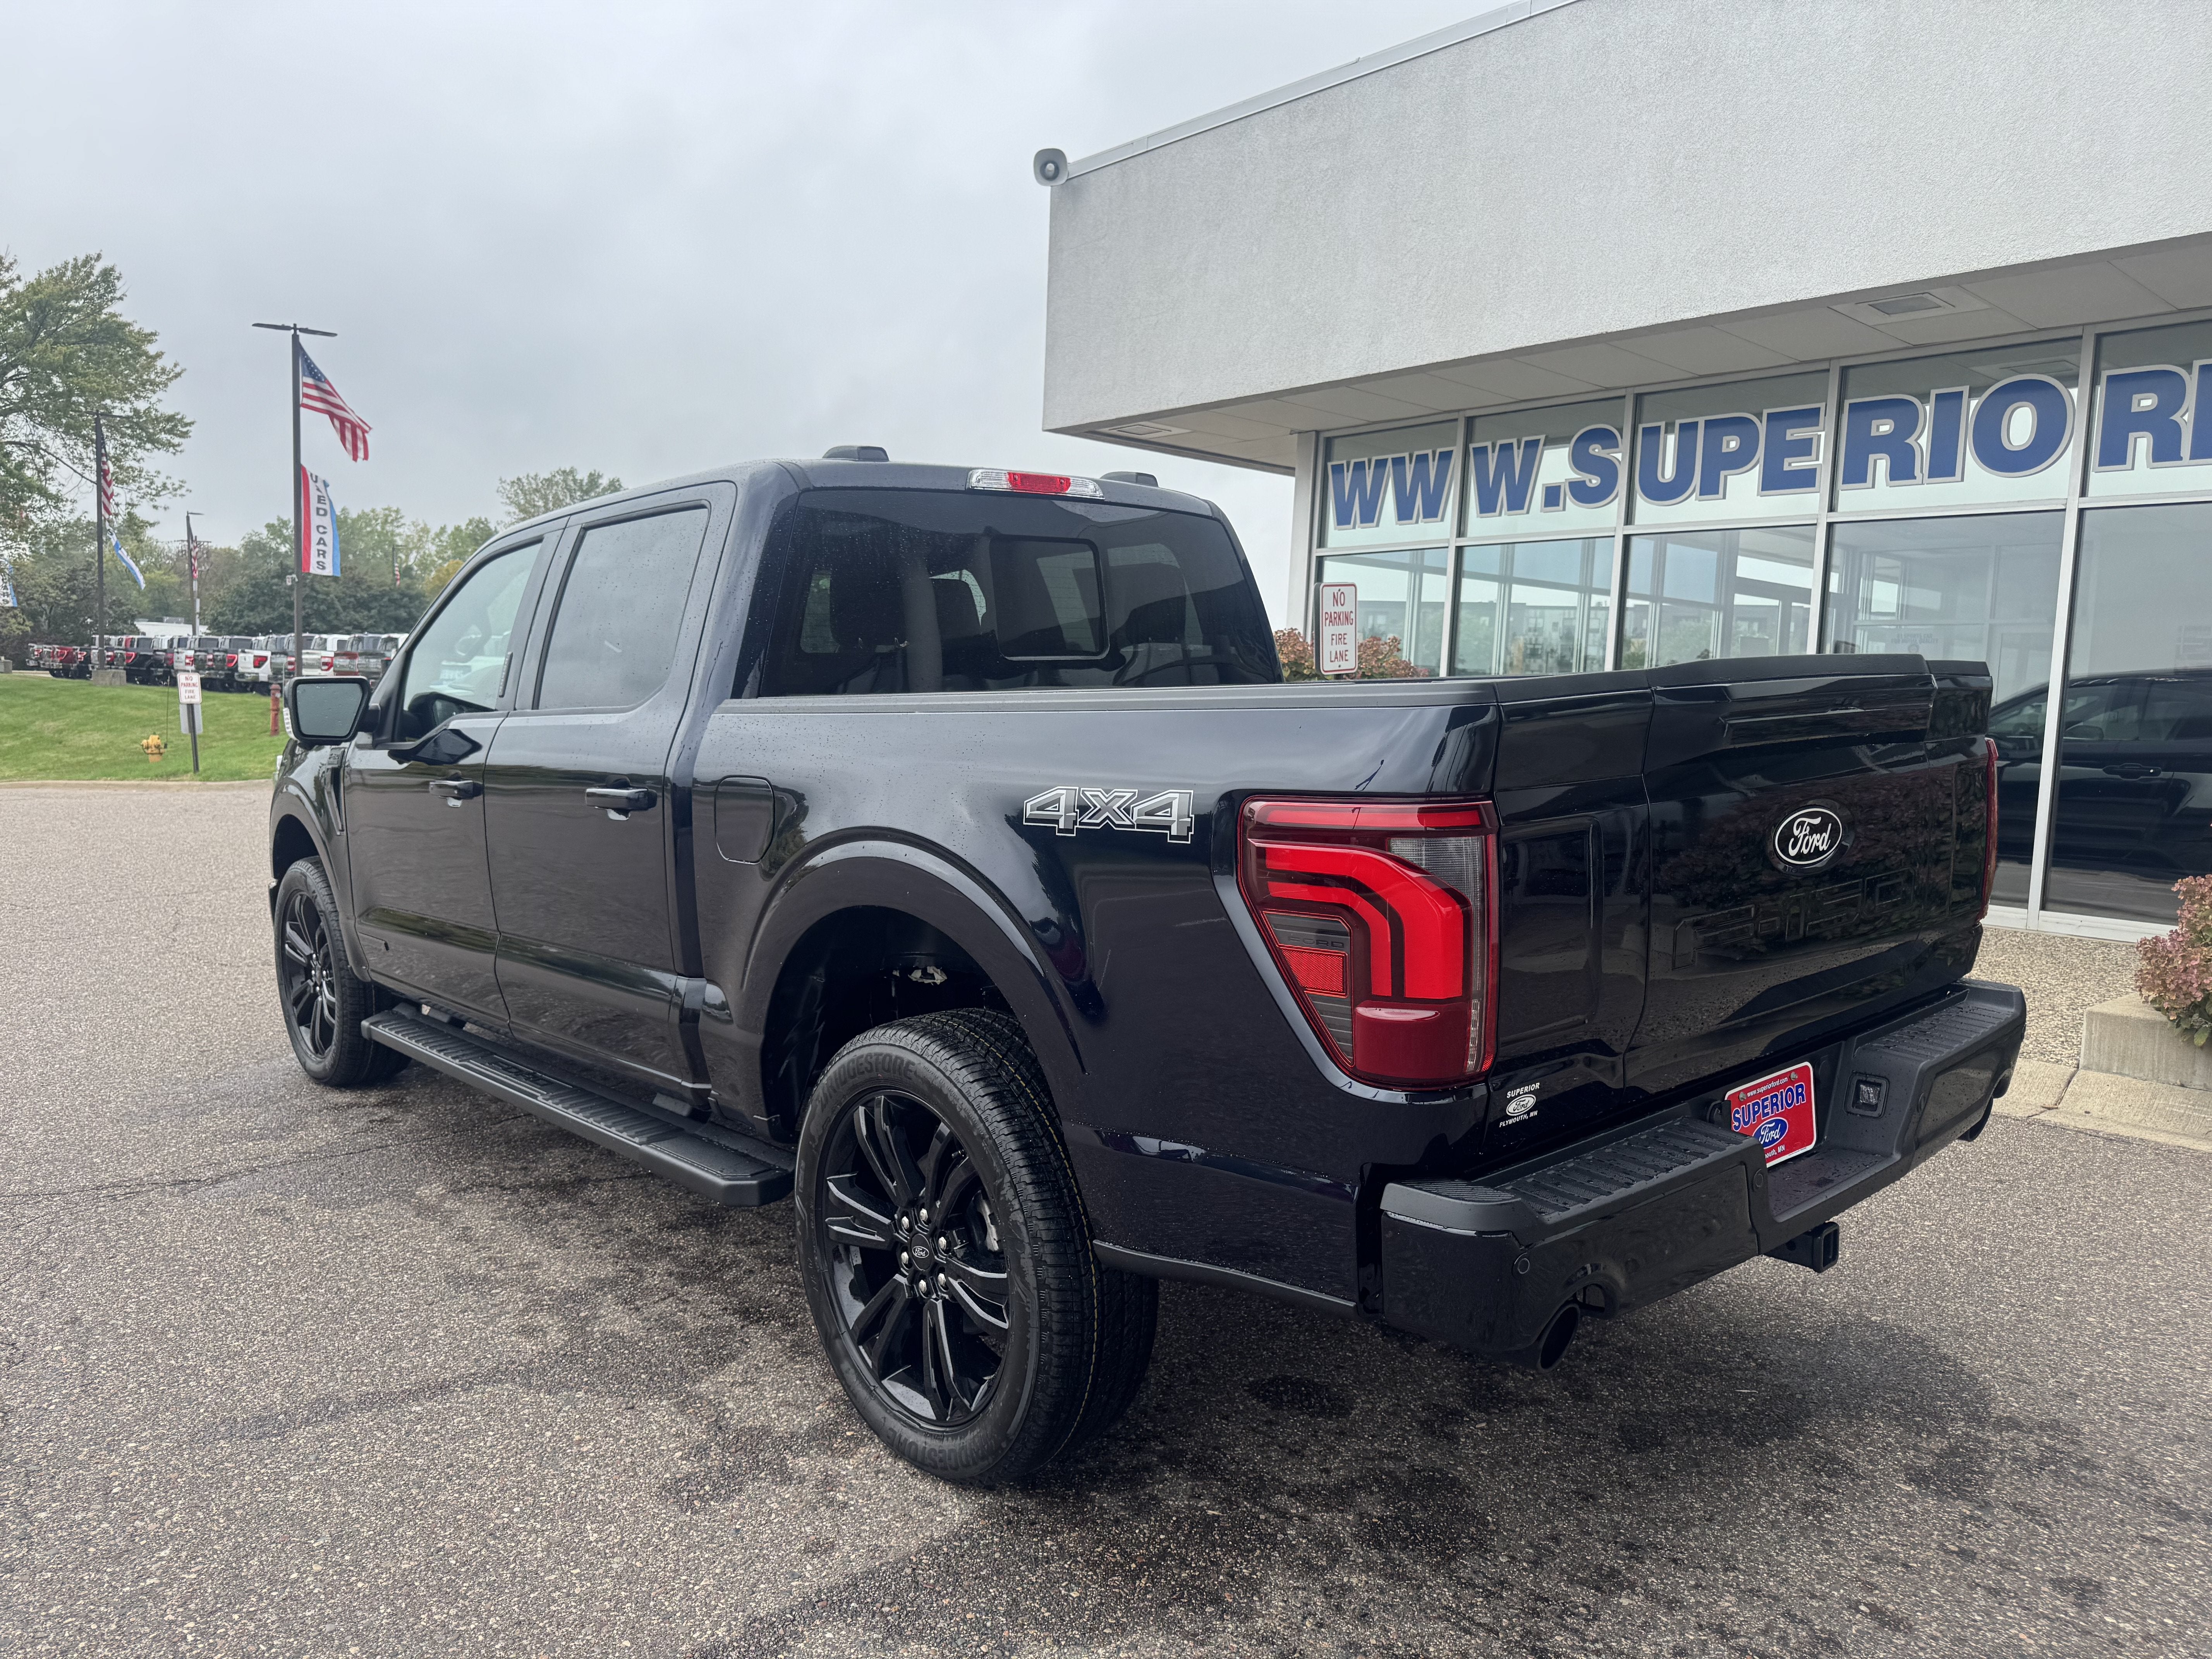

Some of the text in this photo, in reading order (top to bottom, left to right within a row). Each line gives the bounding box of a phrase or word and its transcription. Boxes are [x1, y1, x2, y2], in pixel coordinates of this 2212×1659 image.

[316, 525, 328, 570] CARS
[1333, 591, 1345, 607] NO
[1324, 611, 1353, 627] PARKING
[1331, 633, 1347, 646] FIRE
[1329, 650, 1348, 663] LANE
[1788, 817, 1832, 857] Ford
[1672, 867, 1915, 970] F-150
[1288, 937, 1345, 948] FORD
[1506, 1082, 1540, 1098] SUPERIOR
[1747, 1077, 1788, 1097] www.superiorford.com
[1513, 1099, 1530, 1112] Ford
[1732, 1082, 1806, 1132] SUPERIOR
[1499, 1113, 1528, 1128] PLYMOUTH,
[1759, 1122, 1781, 1144] Ford
[1778, 1144, 1785, 1153] MN
[915, 1247, 926, 1256] Ford
